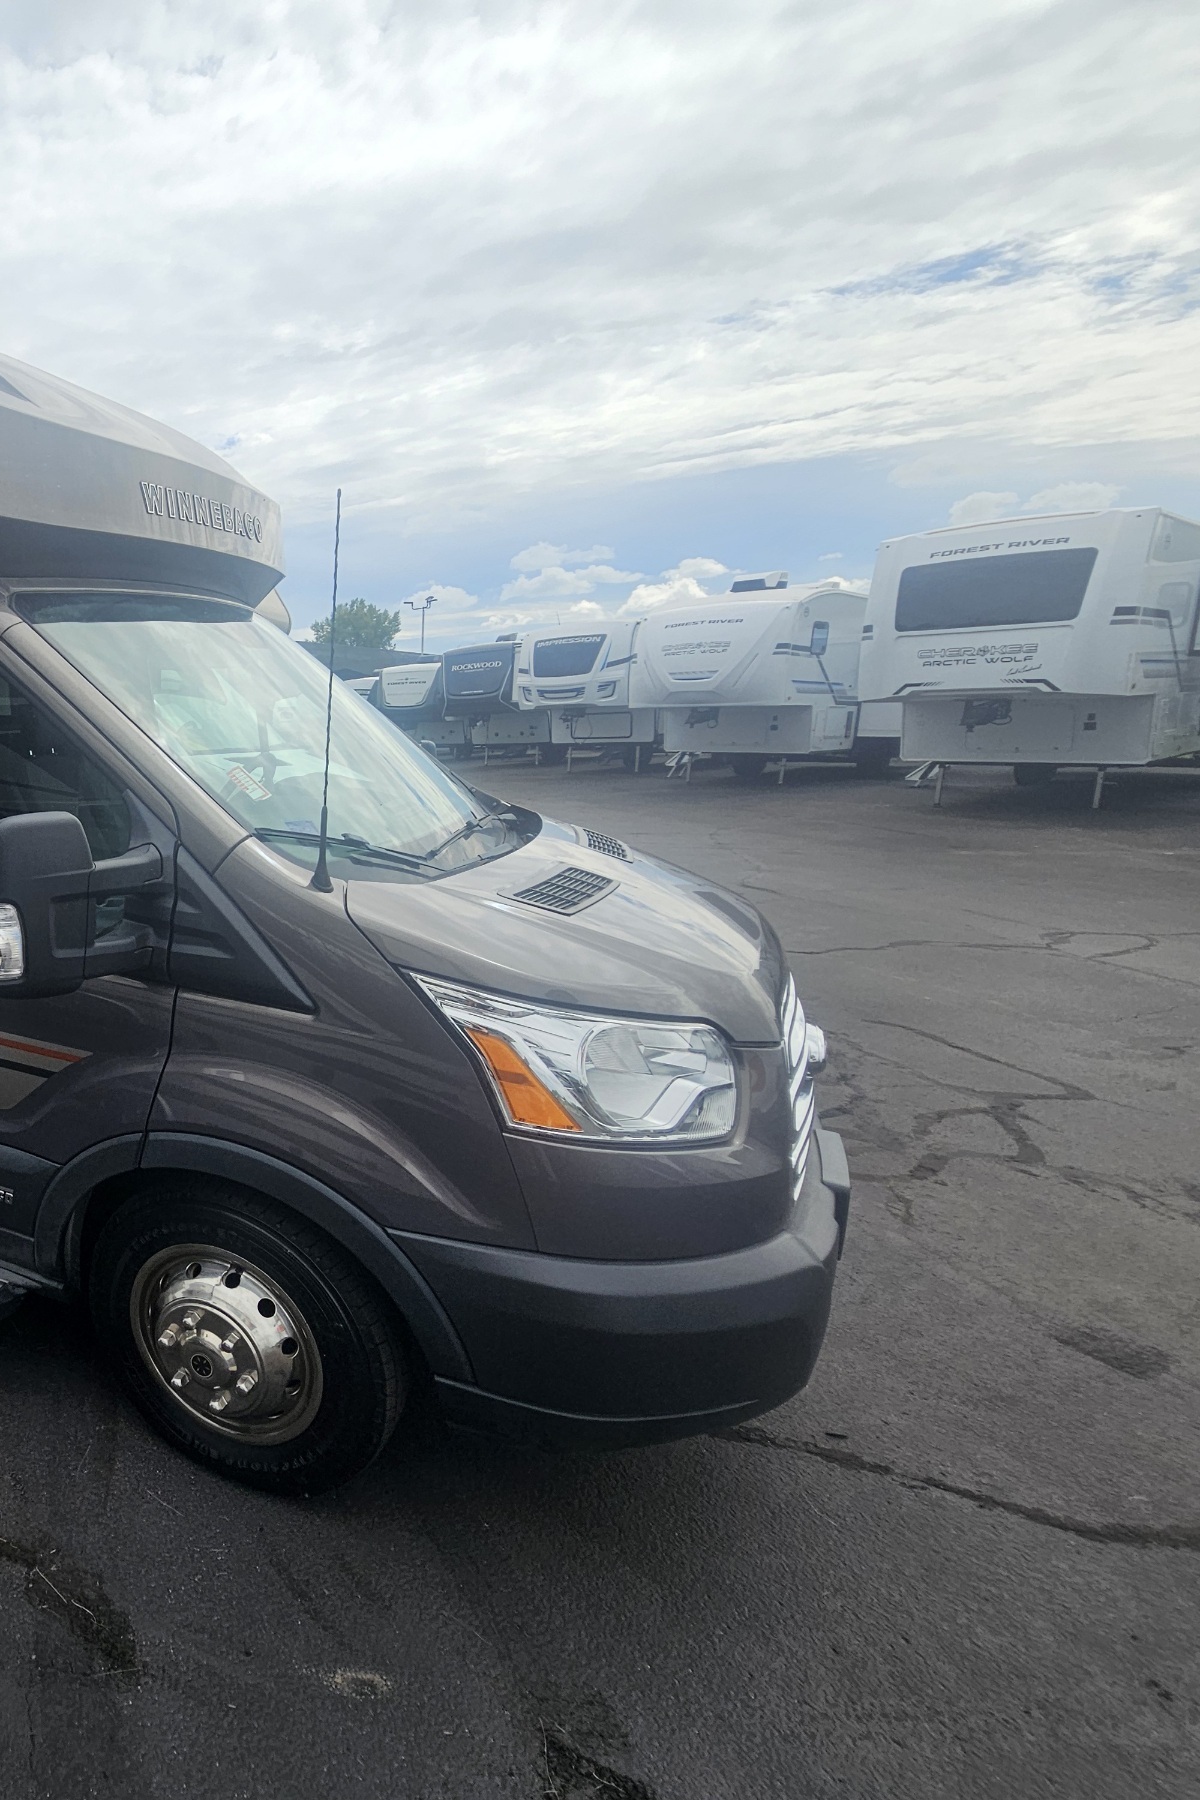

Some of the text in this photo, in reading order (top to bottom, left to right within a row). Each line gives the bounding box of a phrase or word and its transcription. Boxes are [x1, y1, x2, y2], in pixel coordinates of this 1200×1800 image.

[139, 481, 264, 543] WINNEBAGO
[929, 536, 1071, 560] FOREST RIVER
[664, 620, 707, 629] FOREST
[536, 635, 602, 648] IMPRESSION
[451, 660, 502, 672] ROCKWOOD
[922, 655, 1034, 668] ARCTIC WOLF
